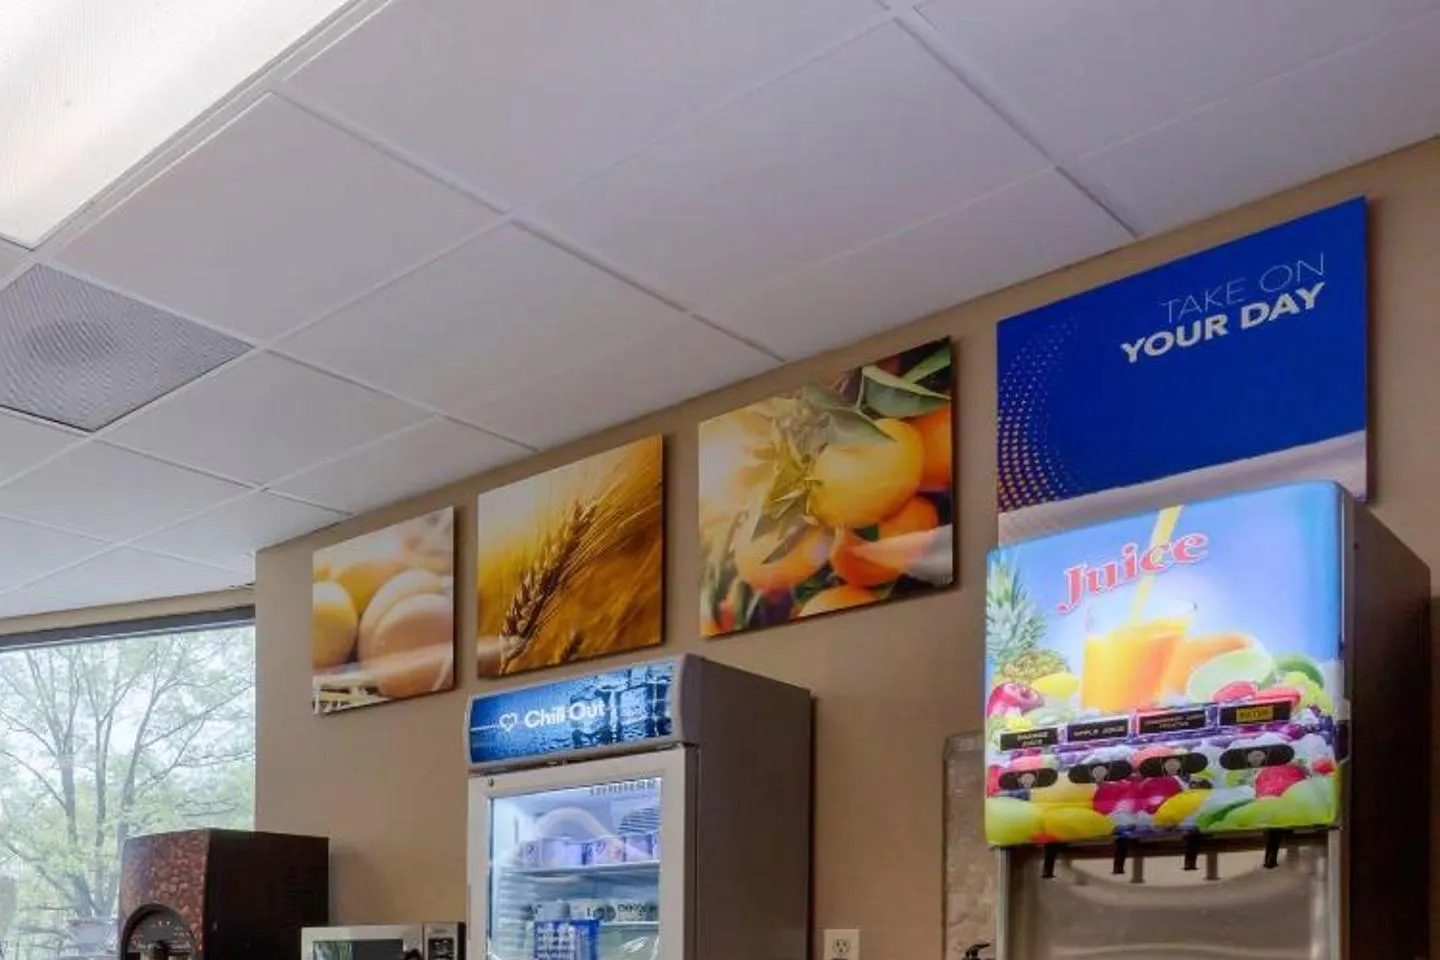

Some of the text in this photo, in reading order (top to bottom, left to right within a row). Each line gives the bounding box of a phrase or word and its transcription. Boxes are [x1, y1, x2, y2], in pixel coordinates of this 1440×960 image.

[1120, 281, 1325, 364] YOUR DAY
[1161, 252, 1324, 323] TAKE ON
[1056, 532, 1209, 615] Juice
[524, 699, 606, 728] Chill Out
